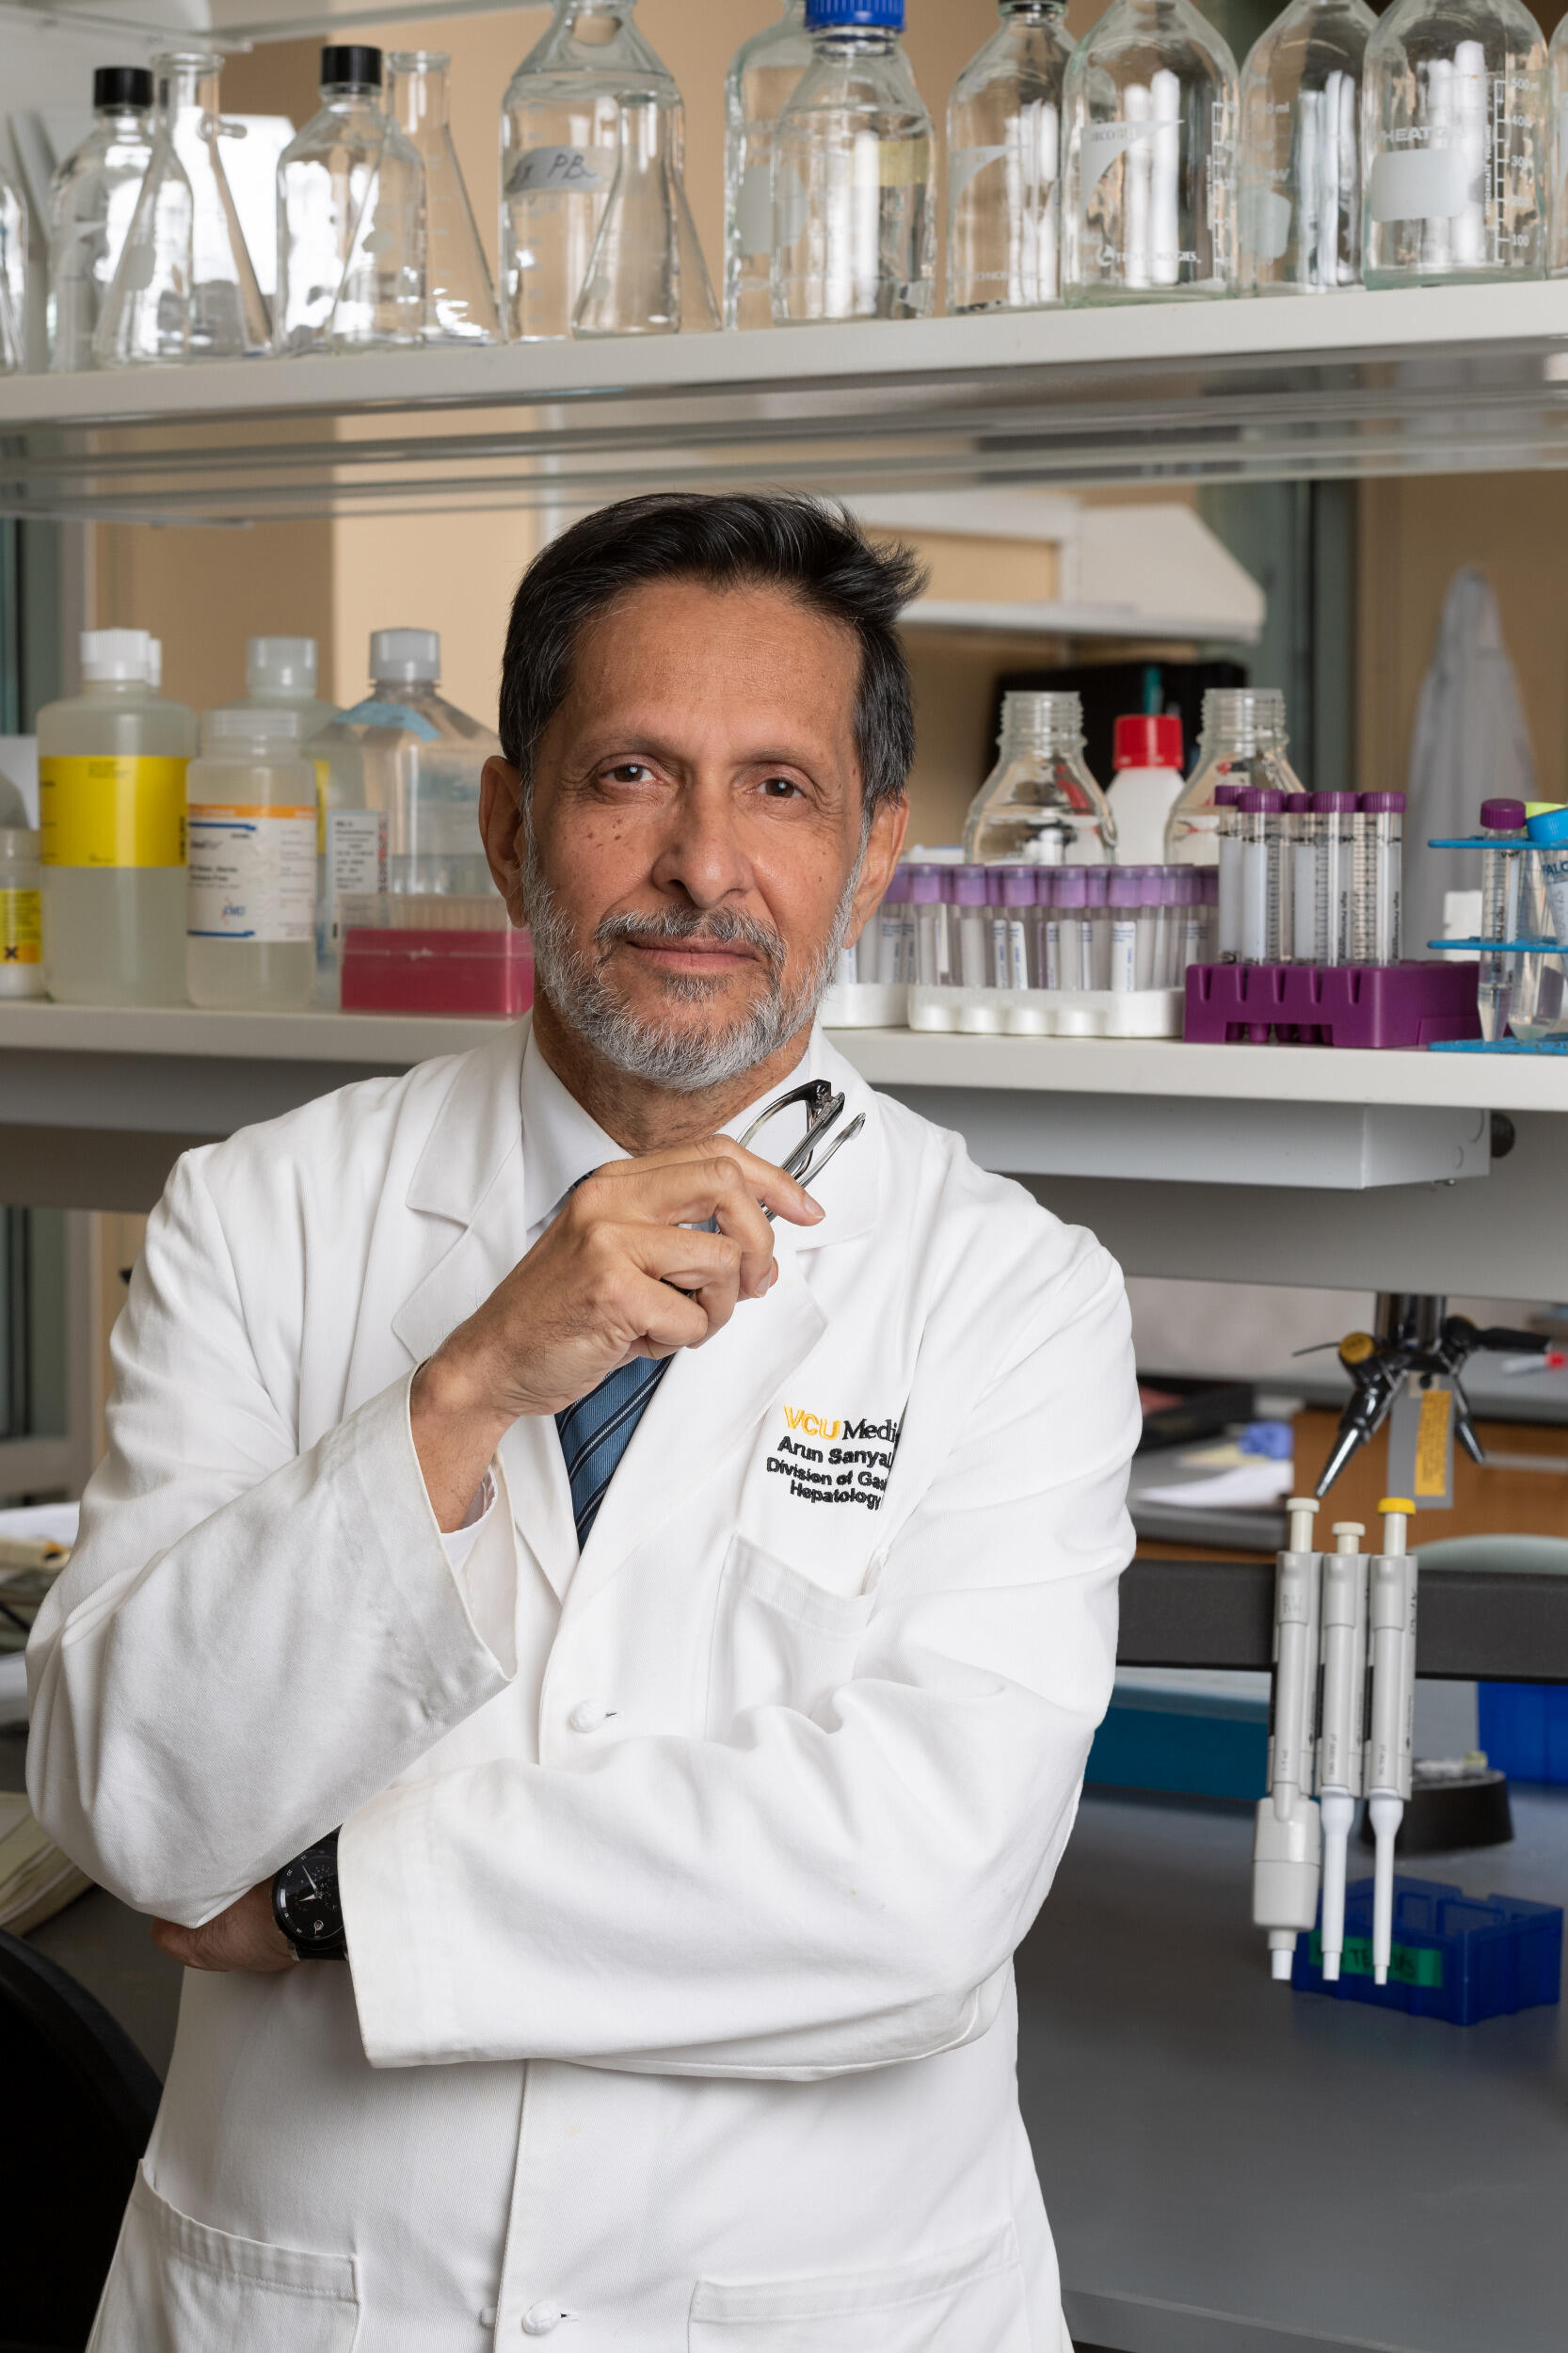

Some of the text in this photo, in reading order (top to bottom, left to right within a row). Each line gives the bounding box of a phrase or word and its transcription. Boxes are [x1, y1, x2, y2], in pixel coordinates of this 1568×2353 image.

[783, 1404, 841, 1441] VCU
[777, 1435, 824, 1464] Arun
[766, 1456, 833, 1486] Division
[836, 1469, 854, 1486] of
[790, 1479, 882, 1511] Hepatology
